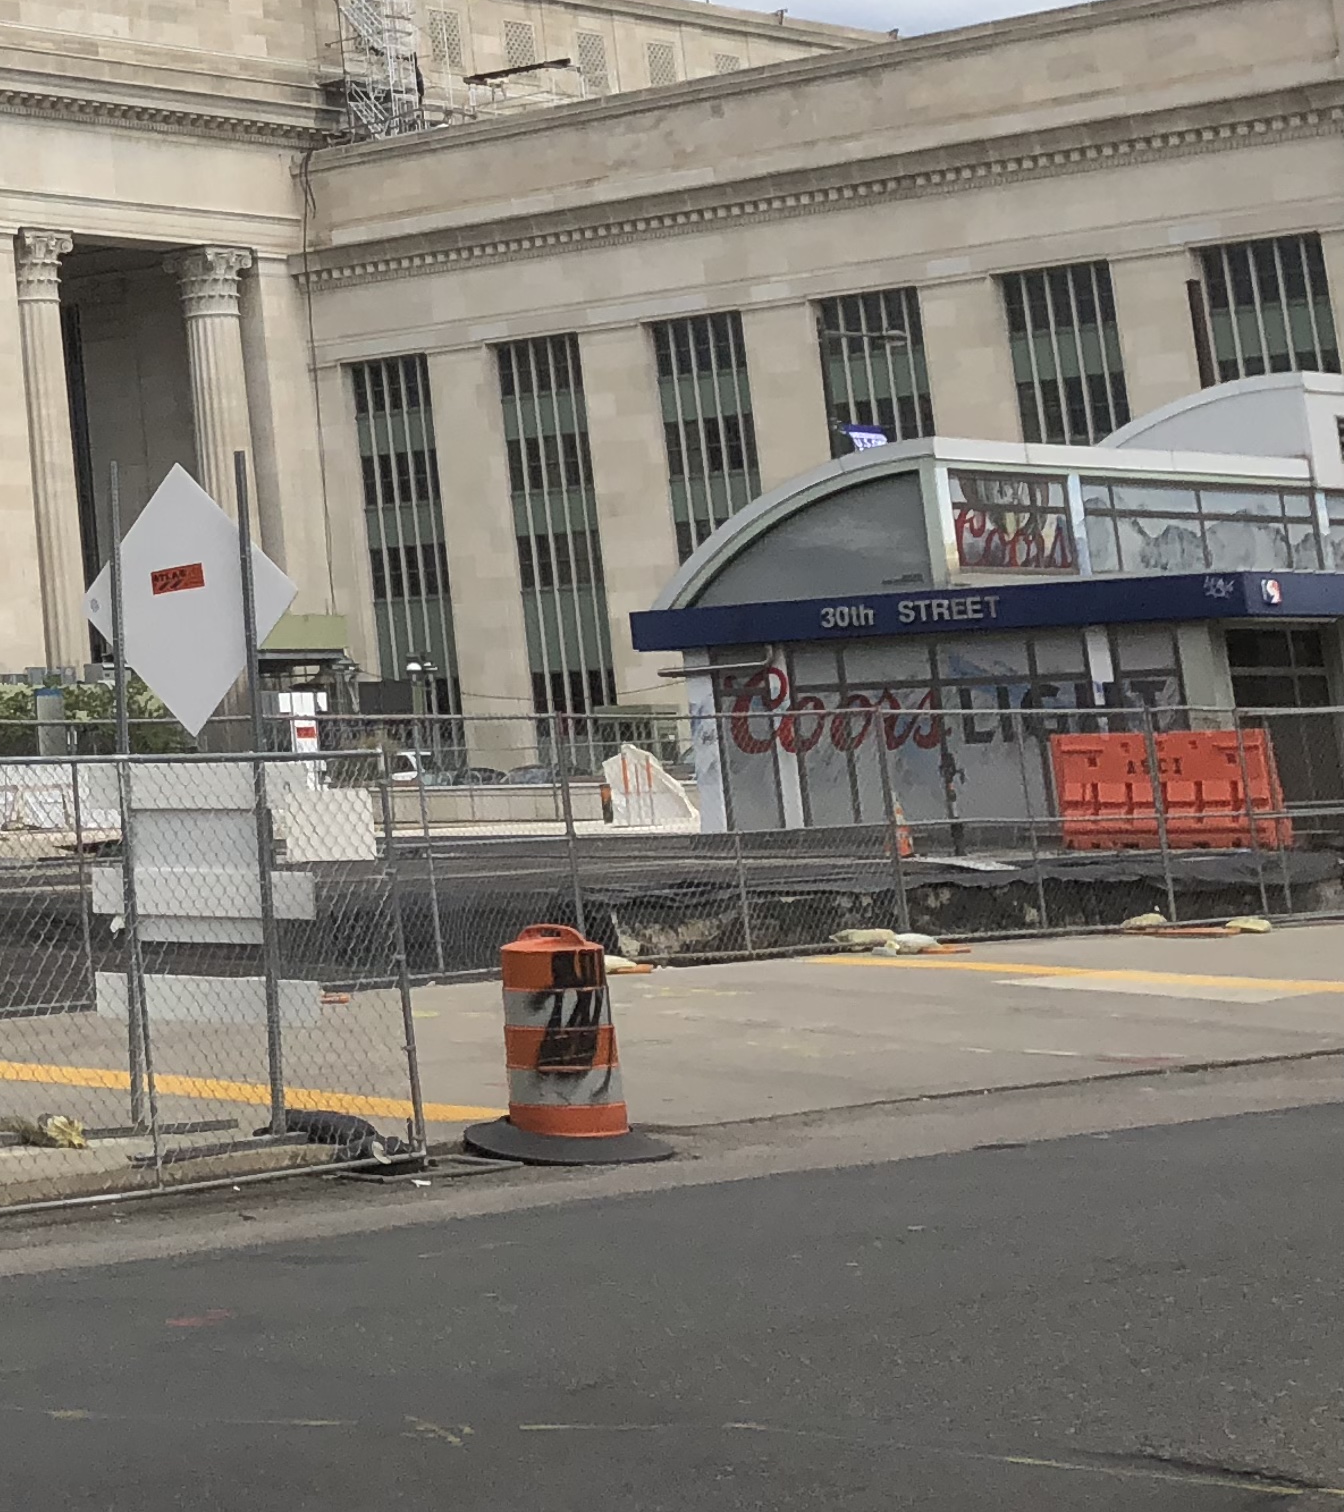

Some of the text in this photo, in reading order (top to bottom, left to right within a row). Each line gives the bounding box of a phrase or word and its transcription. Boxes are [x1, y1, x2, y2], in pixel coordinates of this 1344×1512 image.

[820, 604, 874, 628] 30th
[897, 595, 1000, 624] STREET
[723, 666, 1169, 755] Coors LIGHT
